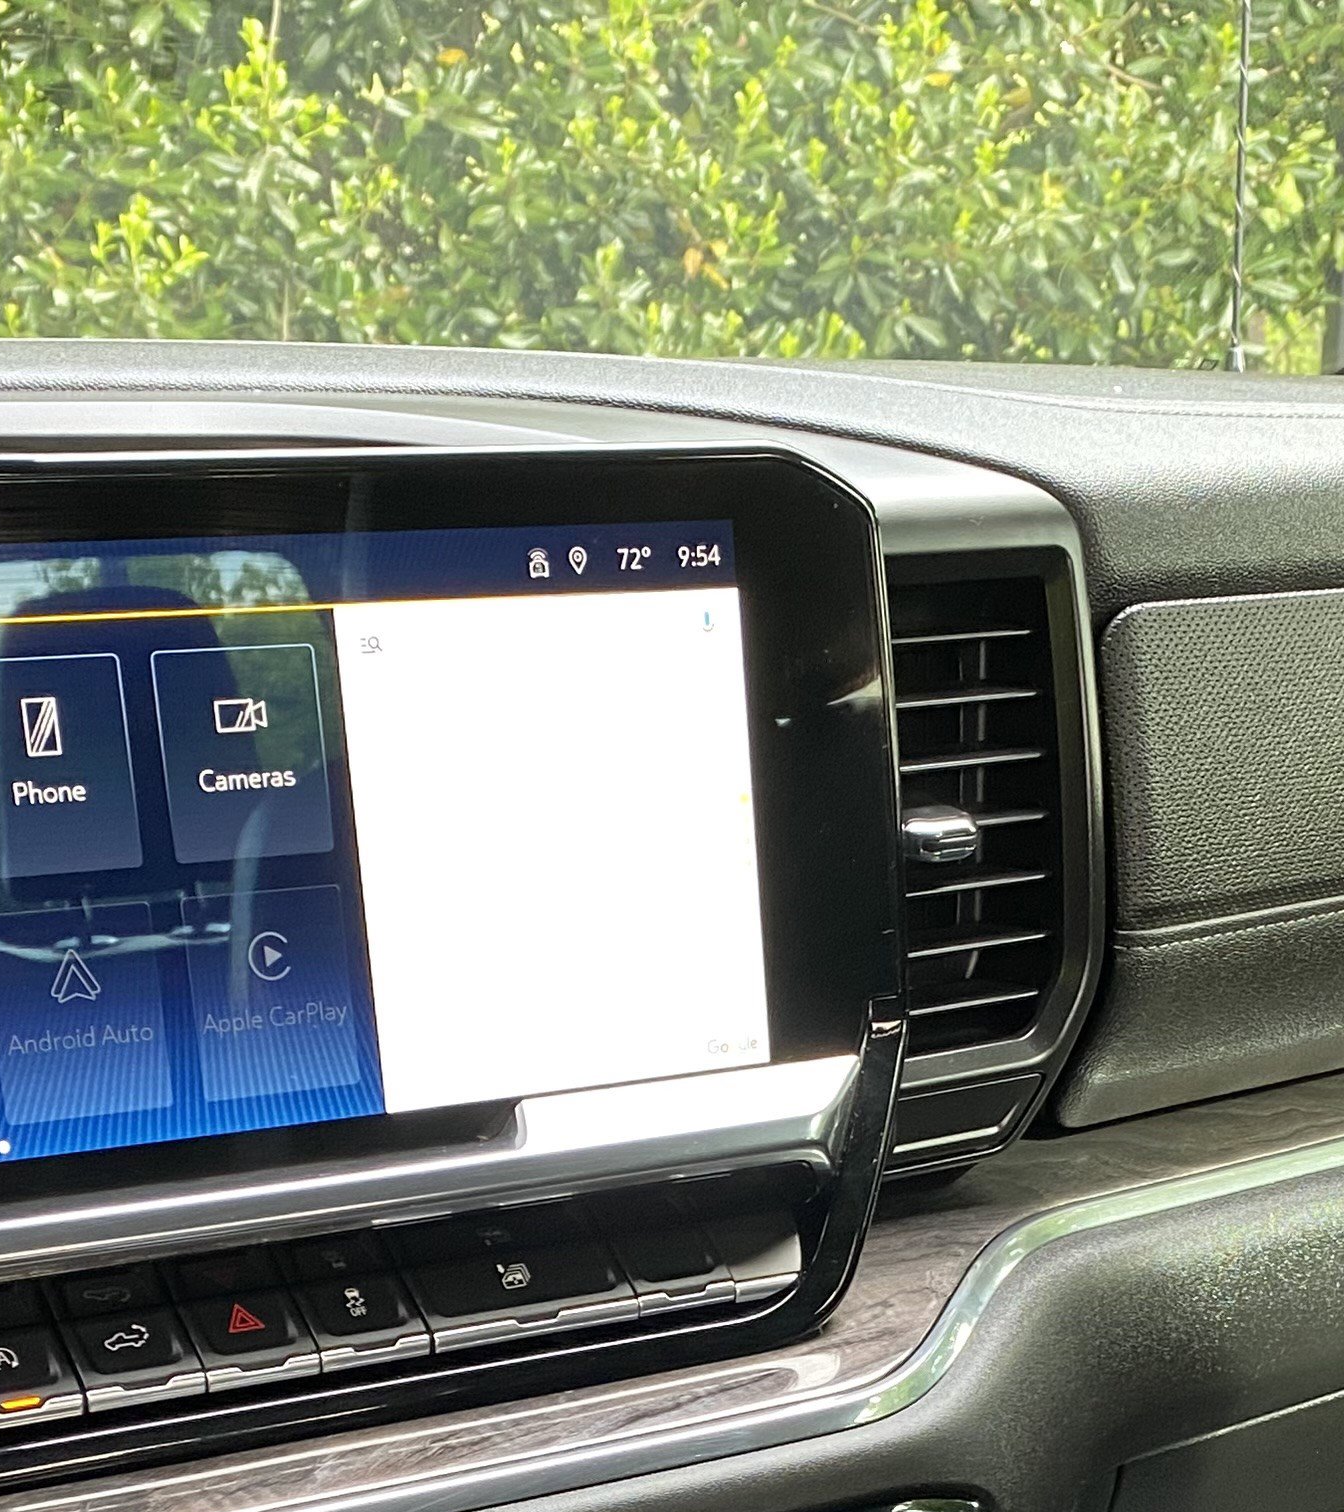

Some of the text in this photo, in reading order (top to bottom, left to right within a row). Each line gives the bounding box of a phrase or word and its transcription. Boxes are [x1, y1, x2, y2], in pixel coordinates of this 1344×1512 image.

[677, 544, 721, 568] 9:54
[12, 780, 87, 806] Phone
[198, 768, 297, 793] Cameras
[202, 1002, 348, 1036] Apple CarPlay
[7, 1023, 153, 1056] Android Auto
[706, 1034, 758, 1055] Gole
[350, 1305, 367, 1317] OFF
